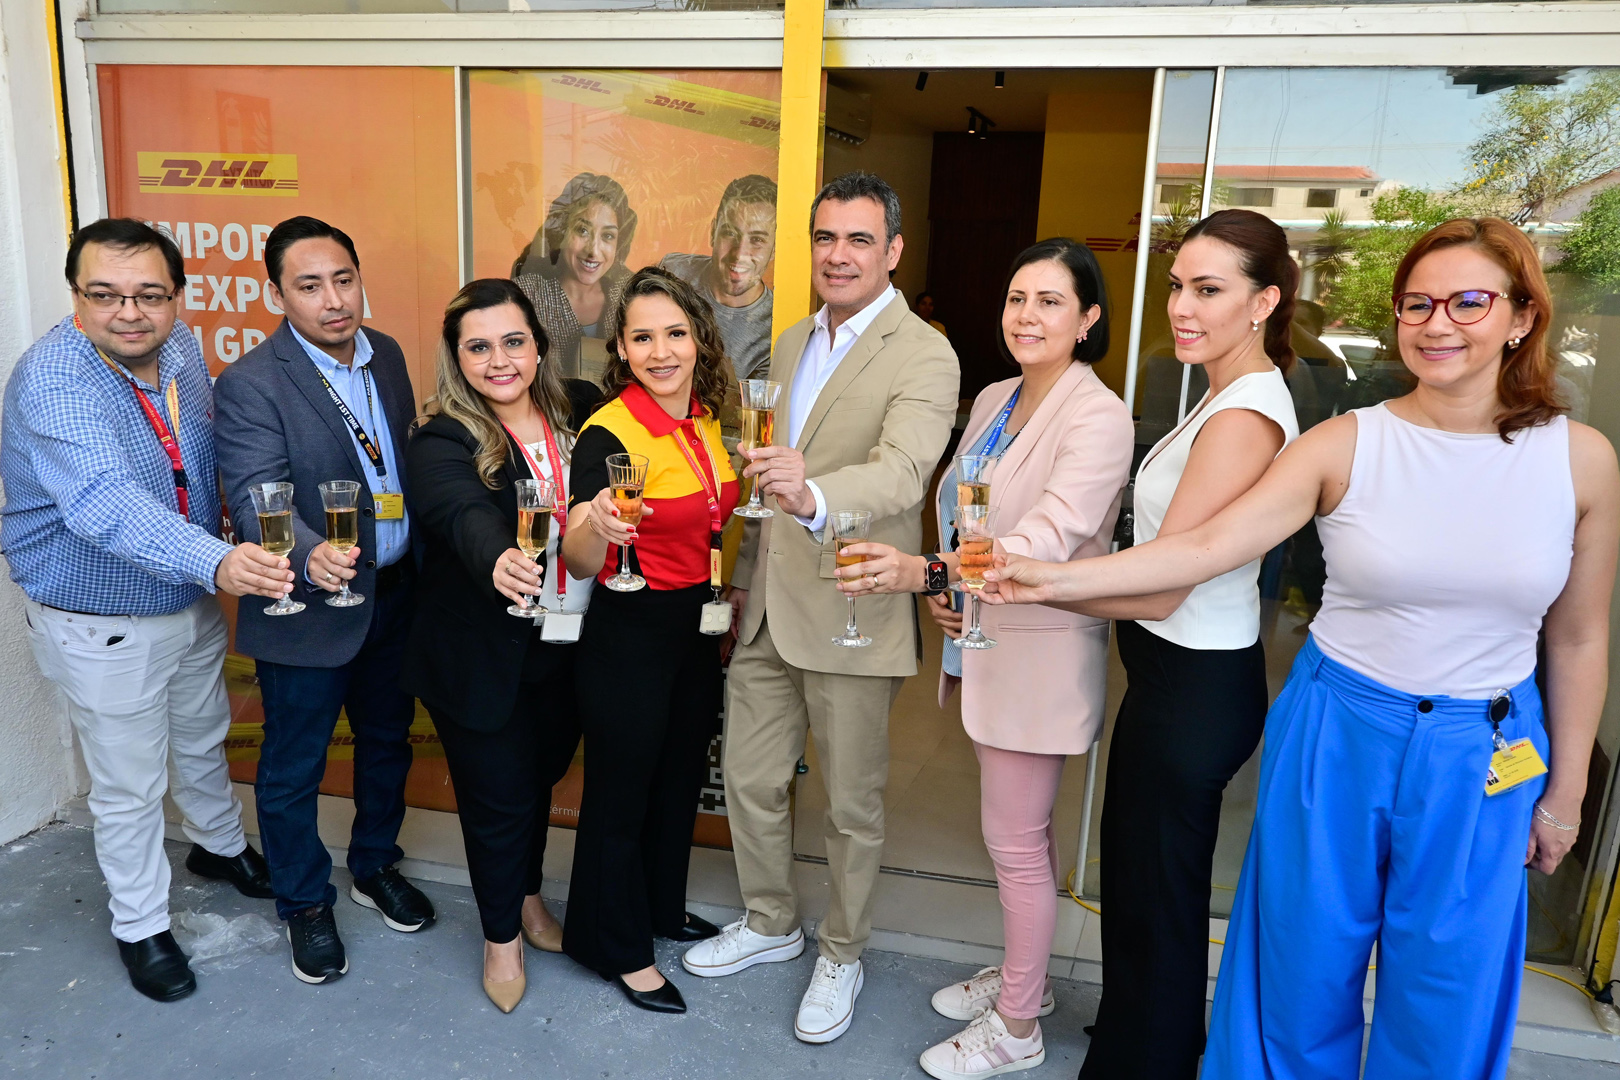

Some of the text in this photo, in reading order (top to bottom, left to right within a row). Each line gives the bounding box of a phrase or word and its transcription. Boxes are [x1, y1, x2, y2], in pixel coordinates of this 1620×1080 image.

[557, 74, 604, 93] DHL
[652, 94, 699, 114] DHL
[748, 115, 780, 132] DH
[159, 159, 277, 189] DHL
[144, 221, 271, 261] MPOR
[346, 414, 360, 431] TIME
[996, 412, 1009, 428] YOU
[549, 804, 580, 818] érmi
